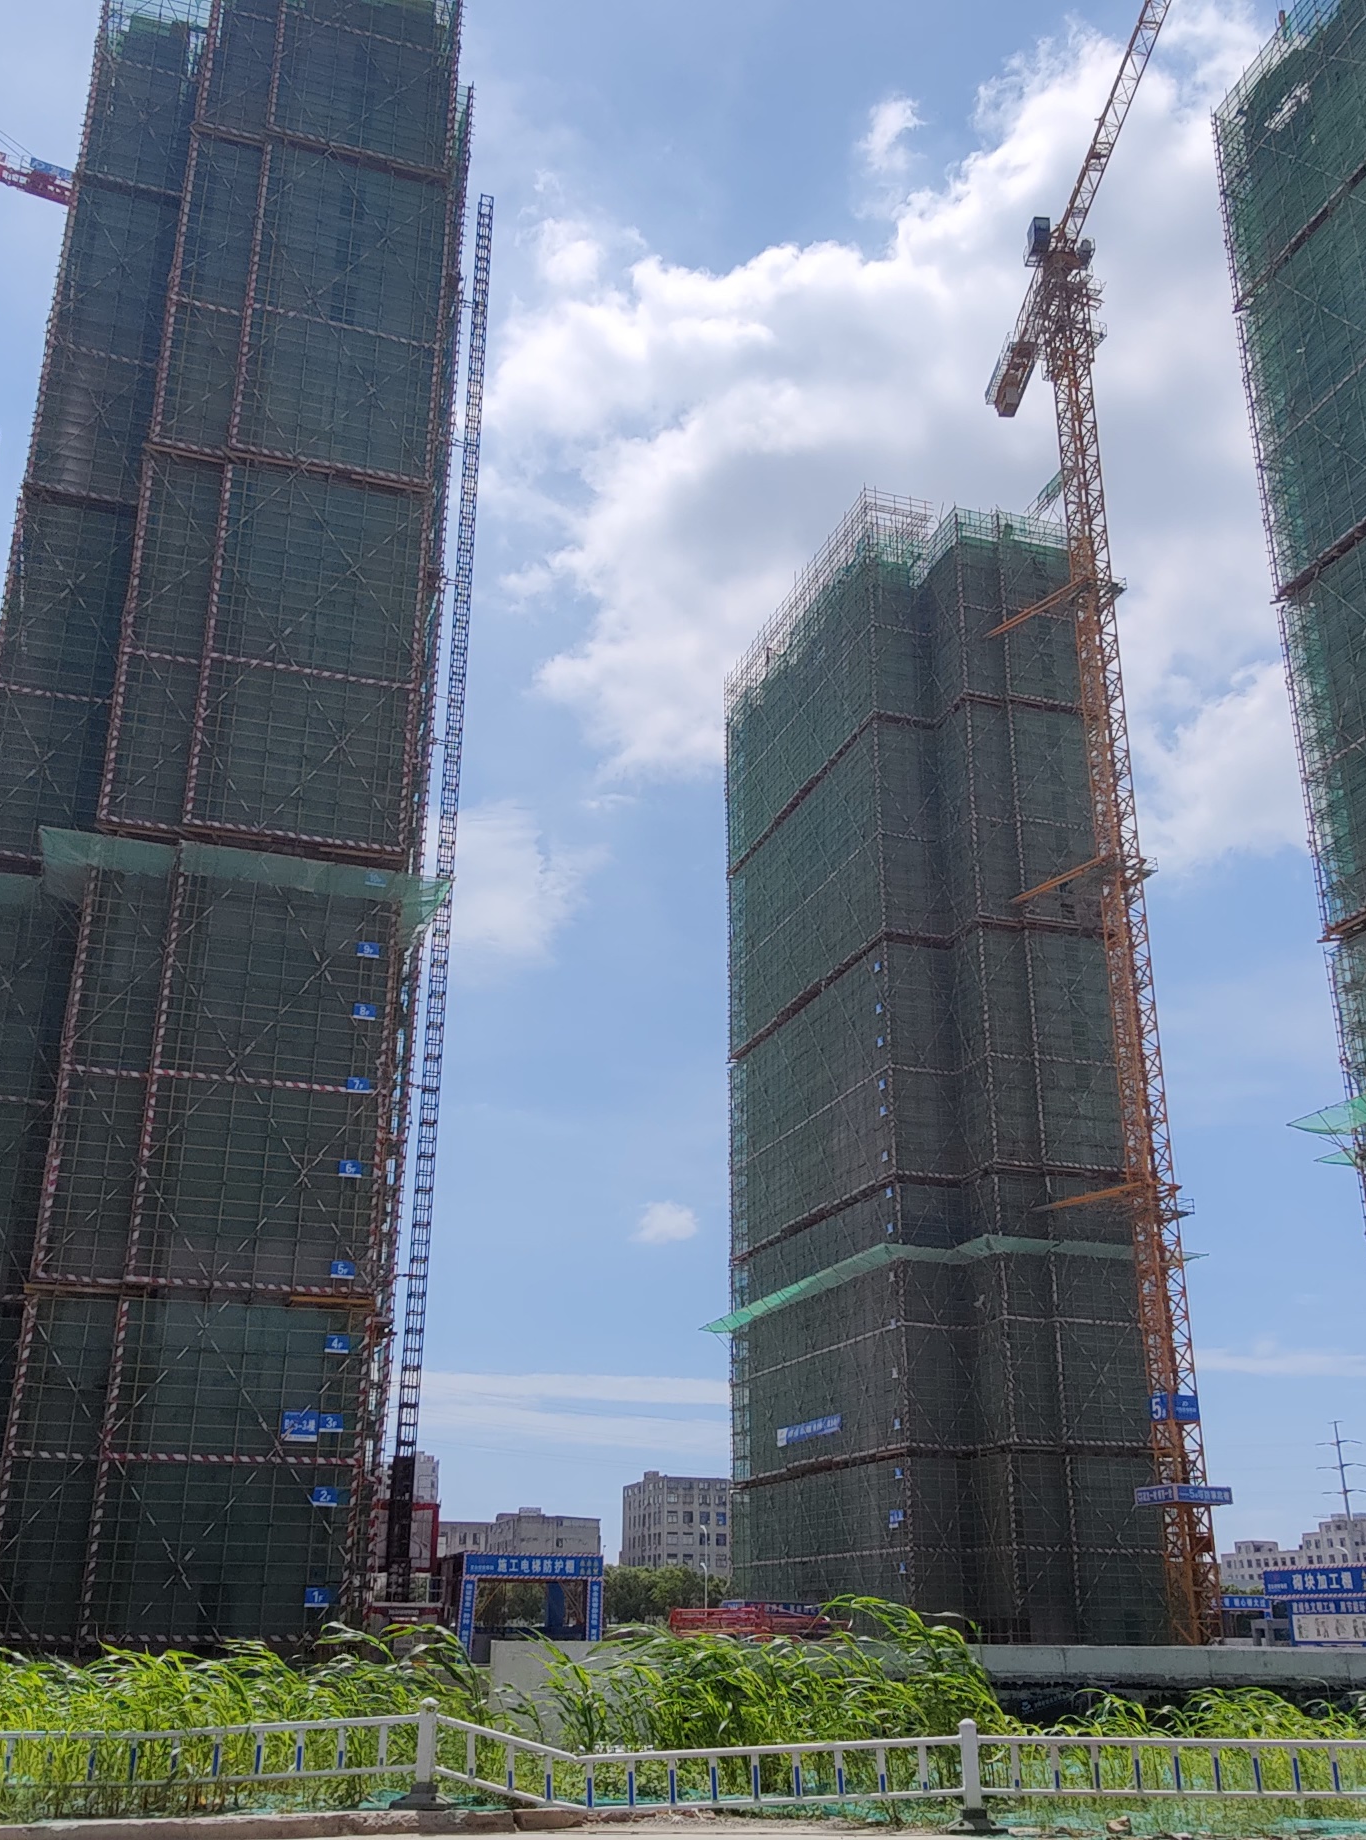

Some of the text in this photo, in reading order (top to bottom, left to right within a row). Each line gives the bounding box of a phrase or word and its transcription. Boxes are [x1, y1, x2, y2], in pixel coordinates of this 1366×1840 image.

[363, 944, 373, 954] 9F
[359, 1005, 370, 1015] 8F
[352, 1080, 363, 1090] 7F
[345, 1163, 356, 1173] 6F
[337, 1263, 349, 1274] 5F
[331, 1337, 343, 1348] 4F
[326, 1416, 338, 1428] 3F
[320, 1489, 332, 1501] 2F
[497, 1558, 575, 1574] 施工电梯防护棚
[312, 1590, 324, 1602] 1F
